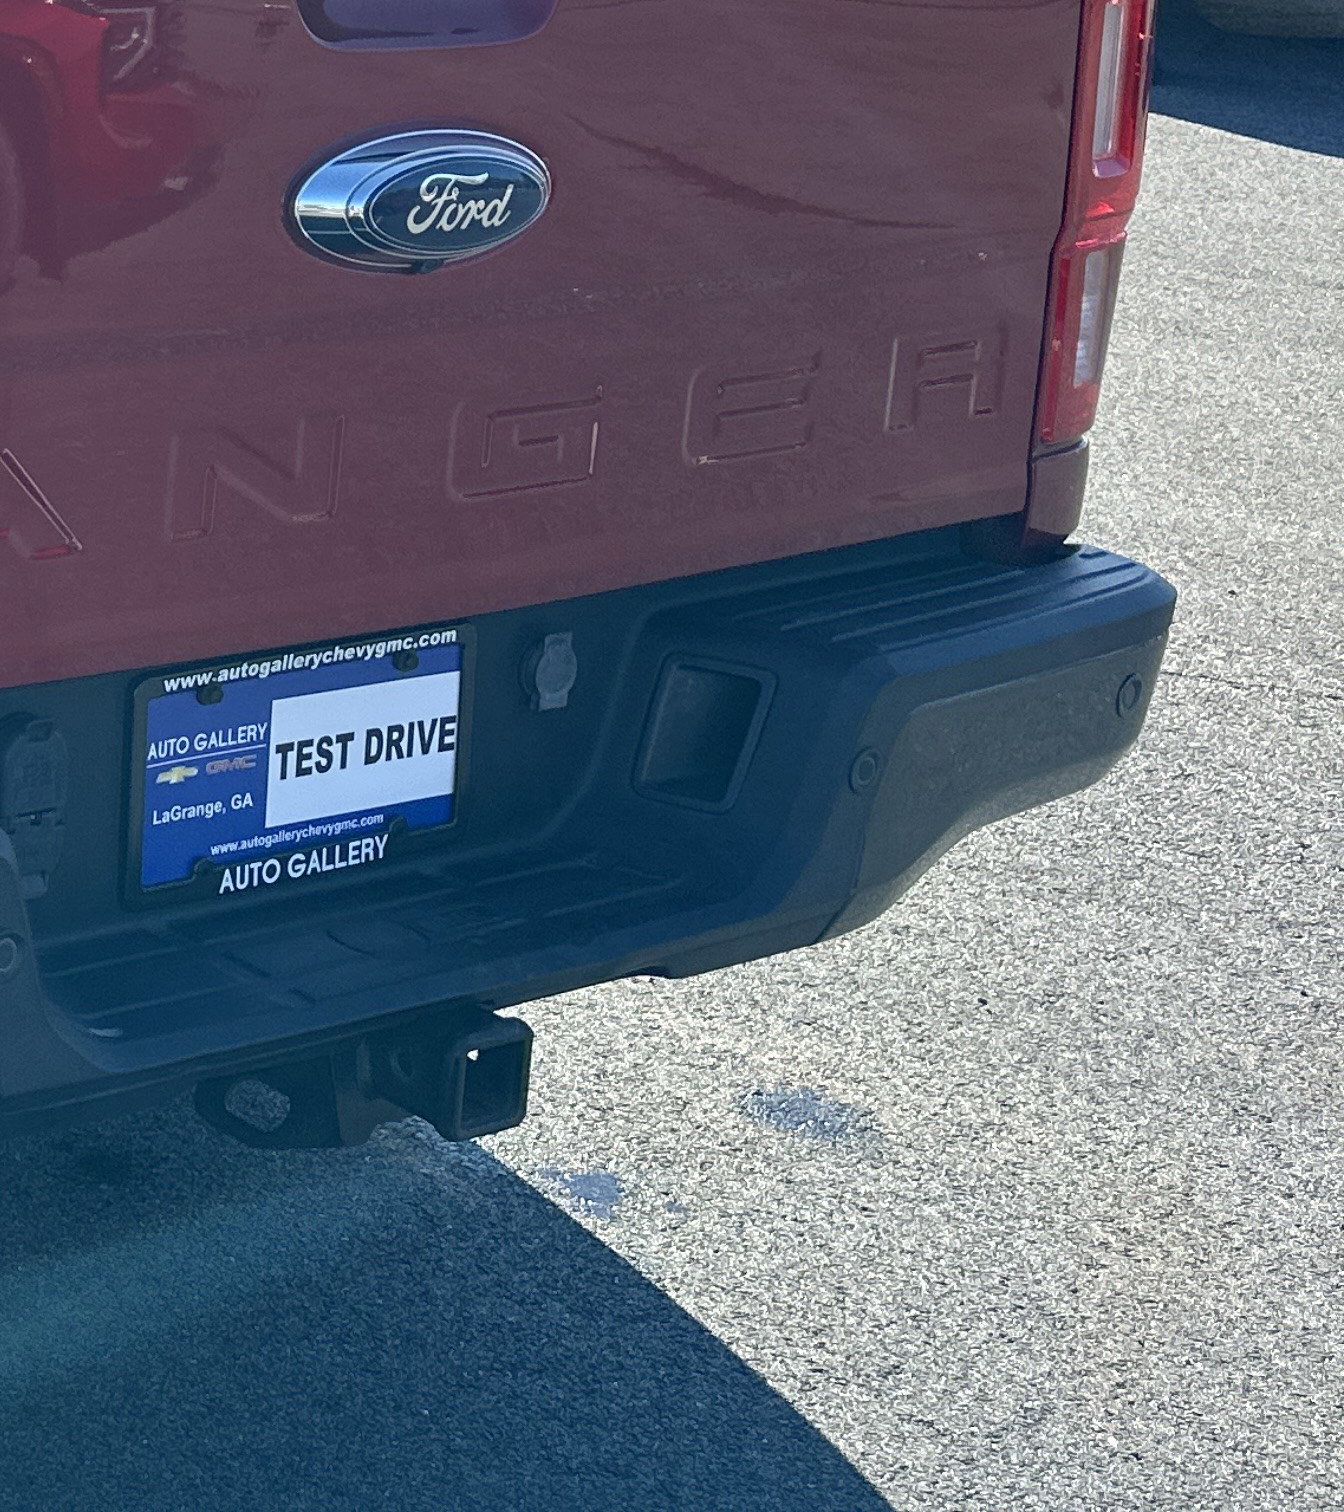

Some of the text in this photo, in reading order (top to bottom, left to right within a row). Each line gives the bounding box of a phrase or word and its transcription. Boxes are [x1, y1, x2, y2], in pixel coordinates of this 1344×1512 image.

[406, 171, 514, 234] Ford
[163, 628, 458, 693] www.autogallerychevygmc.com
[147, 721, 268, 761] AUTO GALLERY
[205, 754, 258, 776] GMC
[275, 714, 457, 781] TEST DRIVE
[152, 792, 254, 826] LaGrange, GA
[210, 813, 385, 856] www.autogallerychevygmc.com
[218, 833, 390, 895] AUTO GALLERY
